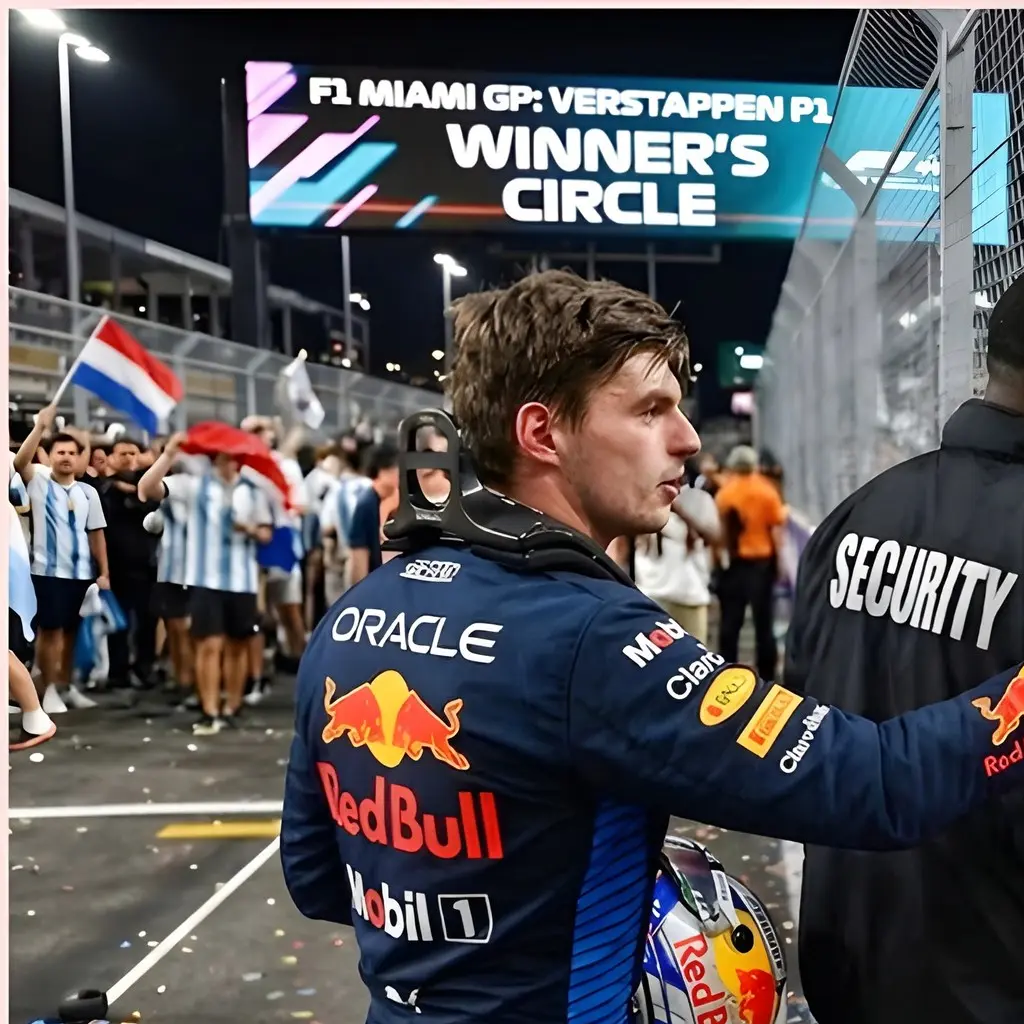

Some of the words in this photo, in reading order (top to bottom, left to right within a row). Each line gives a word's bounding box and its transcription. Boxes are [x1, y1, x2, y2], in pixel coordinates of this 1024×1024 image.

[308, 76, 353, 107] F1
[358, 78, 476, 112] MIAMI
[483, 83, 543, 113] GP:
[548, 87, 785, 124] VERSTAPPEN
[790, 95, 833, 126] P1
[445, 123, 769, 178] WINNER'S
[502, 178, 717, 227] CIRCLE
[830, 533, 1019, 650] SECURITY
[332, 606, 503, 663] ORACLE
[346, 863, 433, 942] Mobil
